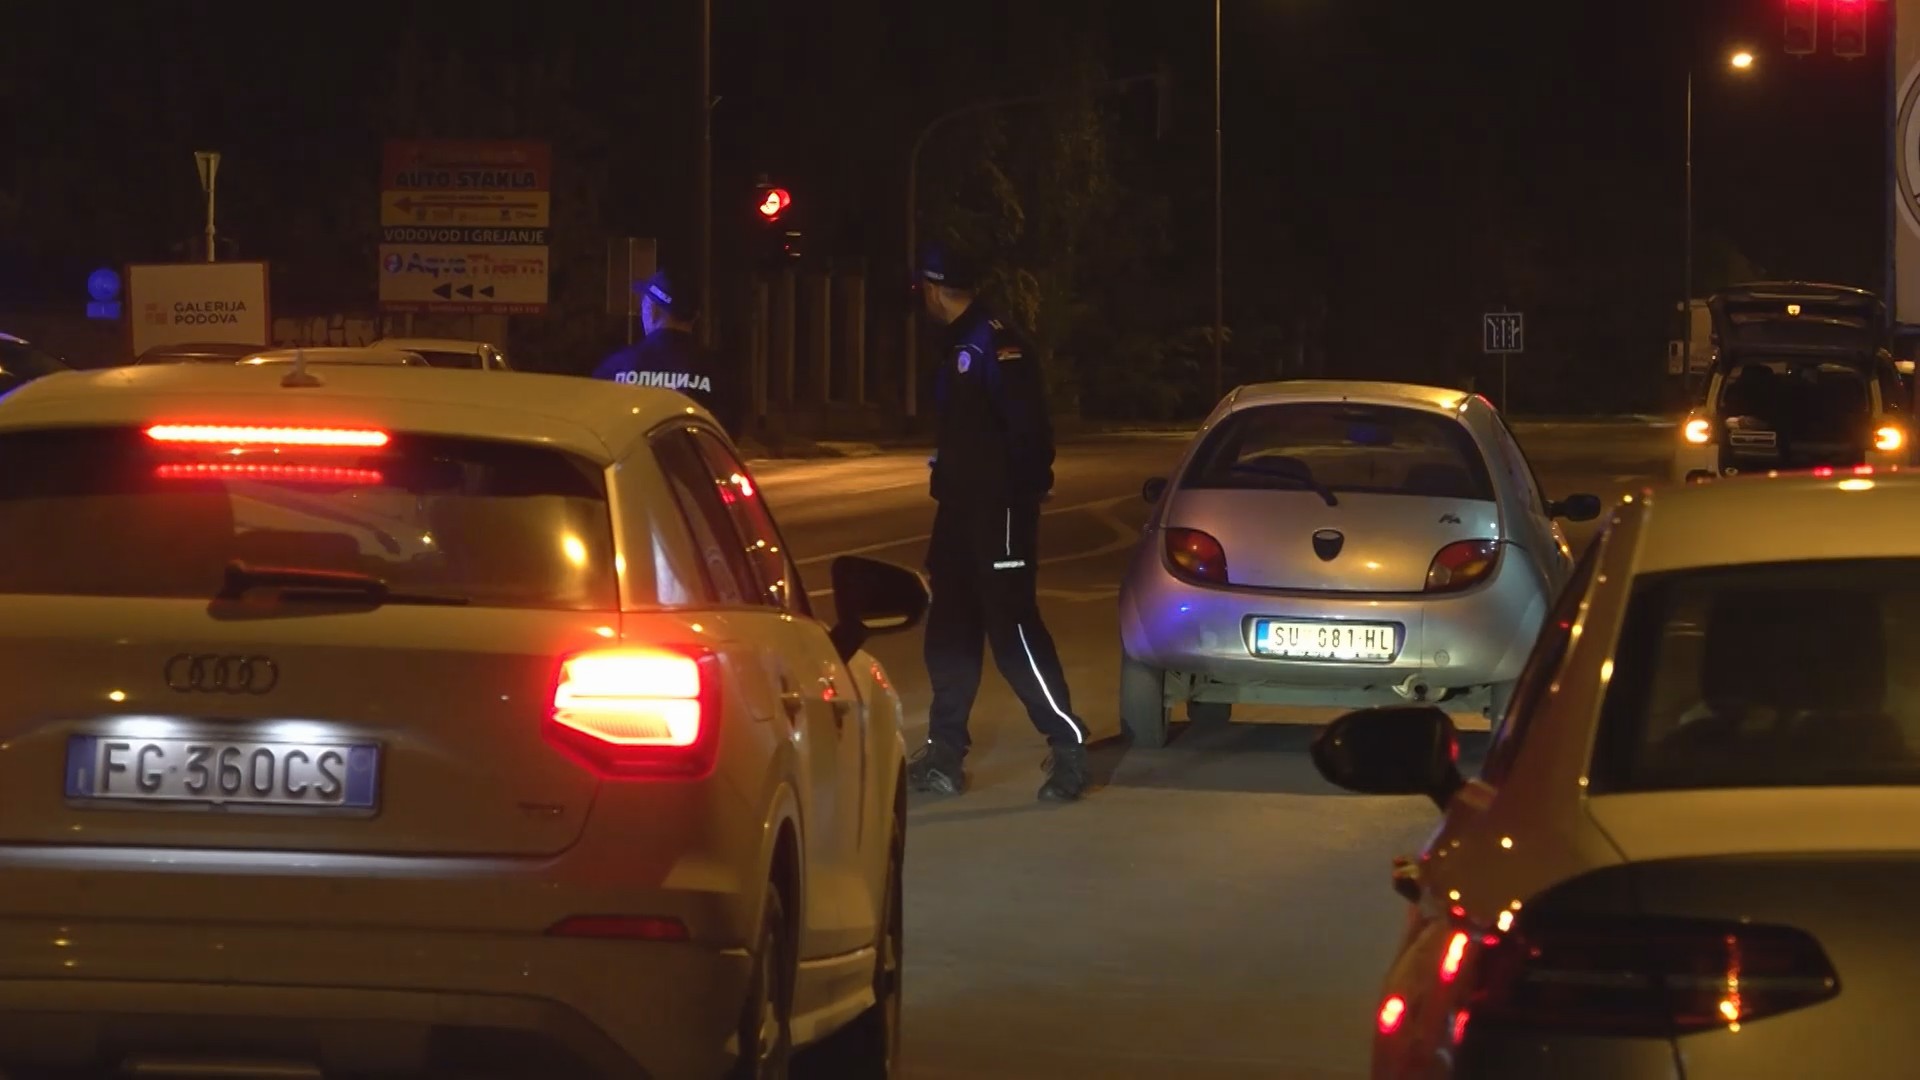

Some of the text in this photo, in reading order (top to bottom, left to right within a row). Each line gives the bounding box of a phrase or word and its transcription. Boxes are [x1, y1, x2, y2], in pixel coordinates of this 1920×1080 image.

[396, 171, 536, 187] AUTO STAKLA
[384, 228, 545, 243] VODOVOD I GREJANJE
[174, 300, 247, 312] GALERIJA
[175, 313, 238, 325] PODOVA
[615, 370, 711, 392] ПОЛИЦИЈА
[1275, 626, 1299, 647] SU
